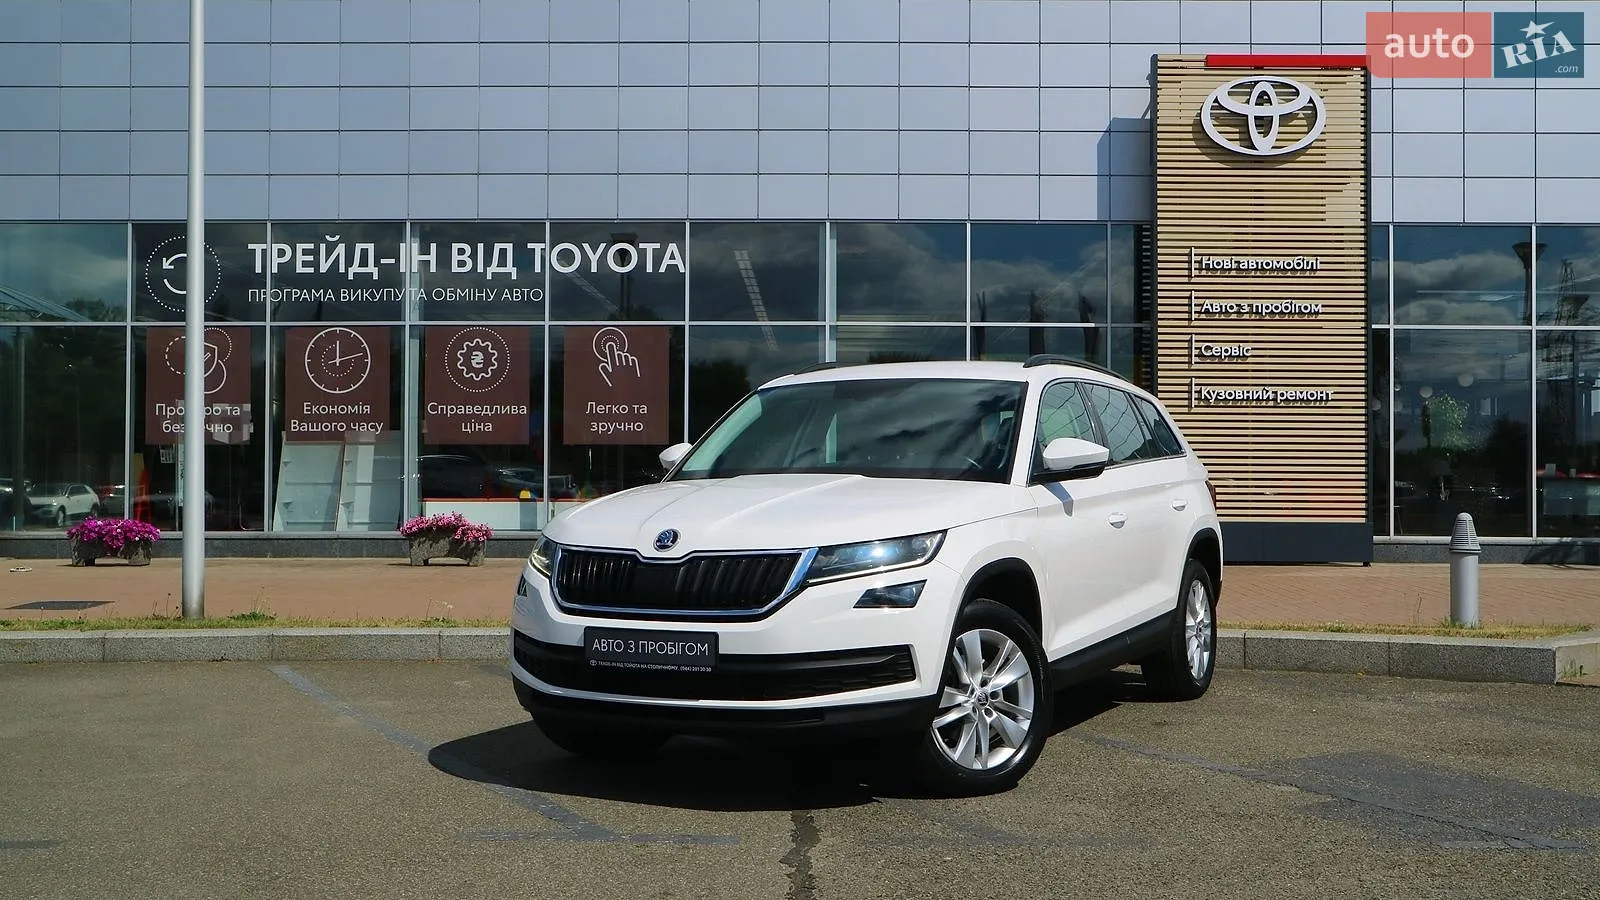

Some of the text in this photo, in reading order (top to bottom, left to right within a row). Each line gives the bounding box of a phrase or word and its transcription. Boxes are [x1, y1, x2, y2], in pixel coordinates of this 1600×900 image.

[247, 234, 686, 280] ТРЕЙД-ІН ВІД TOYOTA
[1201, 255, 1321, 271] Нові автомобілі
[248, 287, 543, 302] ПРОГРАМА ВИКУПУ ТА ОБМІНУ АВТО
[1201, 299, 1322, 316] Авто з пробігом
[1201, 343, 1252, 359] Сервіс
[1201, 386, 1334, 401] Кузовний ремонт
[155, 403, 241, 419] Проро та
[303, 402, 371, 415] Економія
[427, 402, 527, 417] Справедлива
[585, 401, 648, 415] Легко та
[162, 420, 233, 433] безчно
[290, 420, 384, 435] Вашого часу
[461, 419, 493, 433] ціна
[590, 420, 644, 435] зручно
[592, 638, 709, 656] АВТО З ПРОБІГОМ
